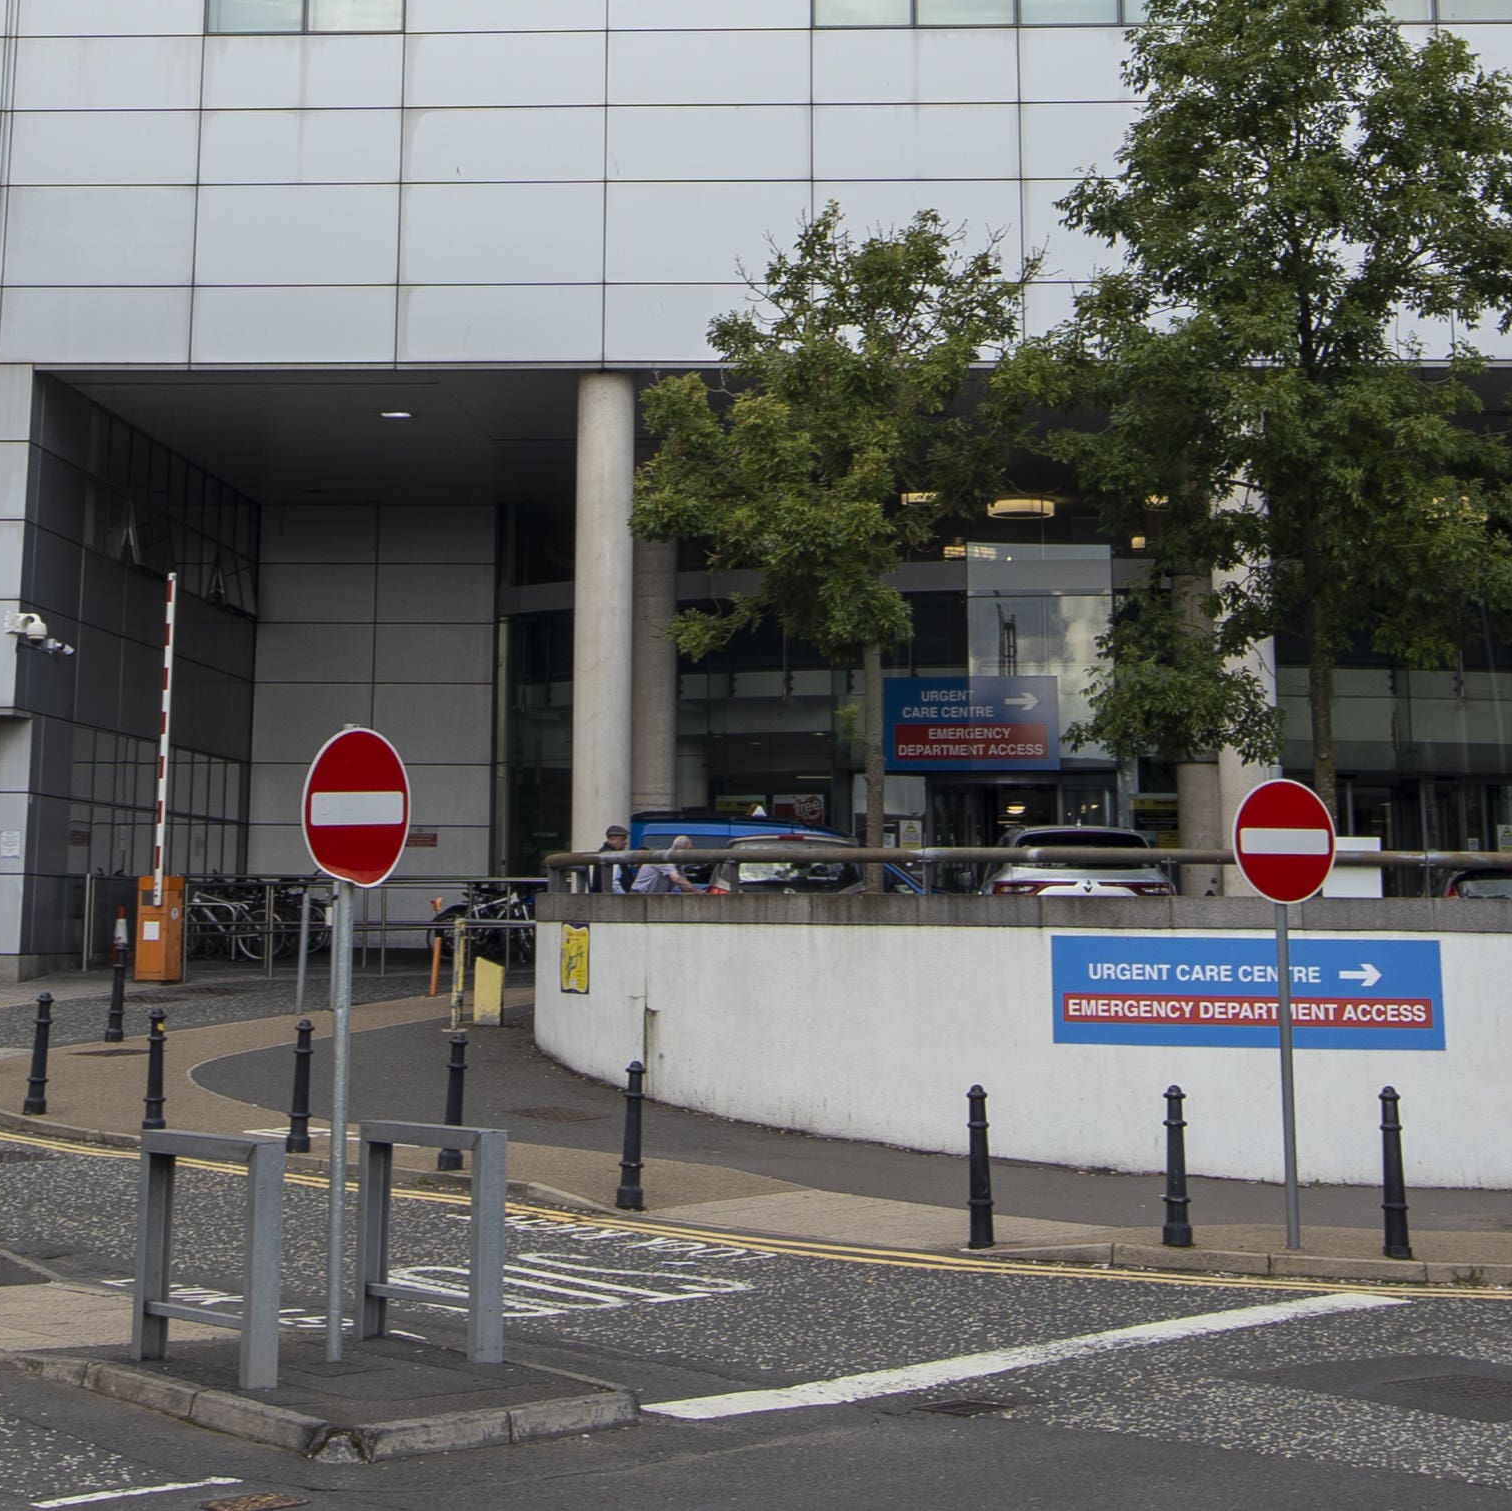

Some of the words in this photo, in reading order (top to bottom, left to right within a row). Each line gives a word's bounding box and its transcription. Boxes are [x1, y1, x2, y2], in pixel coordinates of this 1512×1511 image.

[921, 690, 974, 702] URGENT
[902, 707, 938, 718] CARE
[941, 706, 994, 718] CENTRE
[928, 728, 1011, 740] EMERGENCY
[898, 744, 985, 756] DEPARTMENT
[988, 744, 1044, 756] ACCESS
[1089, 963, 1171, 981] URGENT
[1176, 965, 1233, 982] CARE
[1238, 965, 1321, 983] CENRE
[1068, 999, 1193, 1019] EMERGENCY
[1342, 1003, 1427, 1022] ACCESS
[613, 1237, 777, 1263] LOOK
